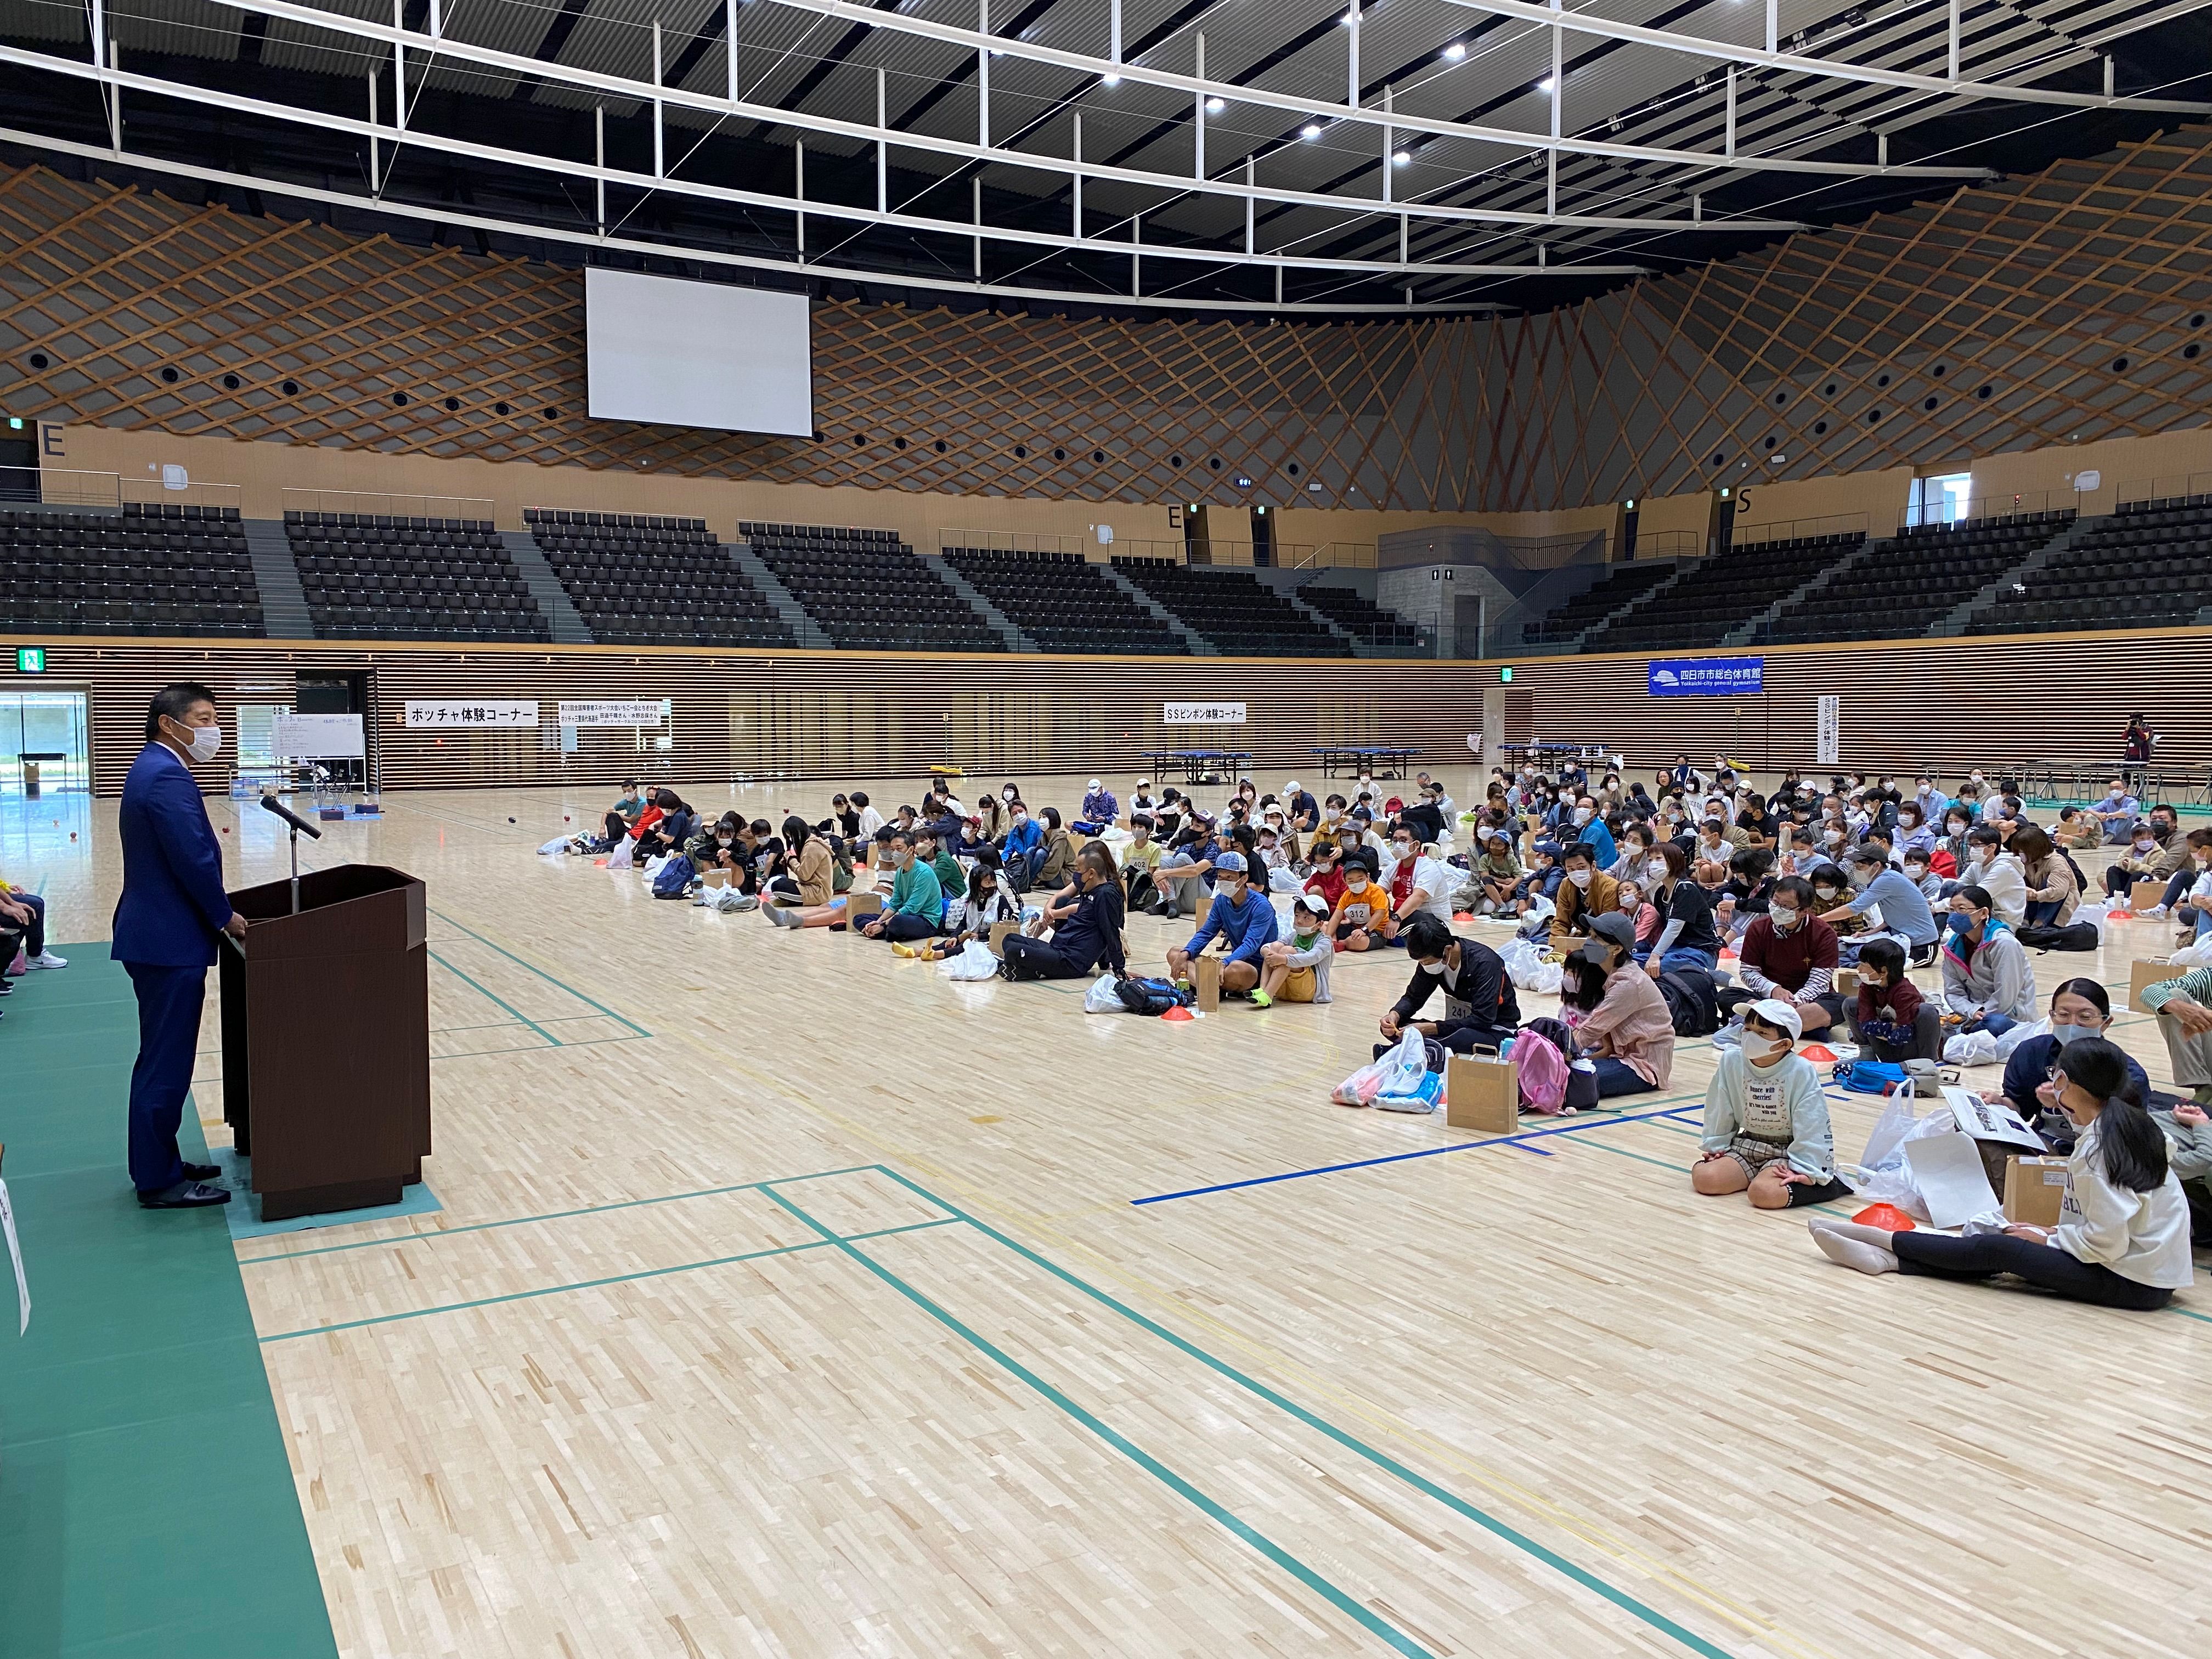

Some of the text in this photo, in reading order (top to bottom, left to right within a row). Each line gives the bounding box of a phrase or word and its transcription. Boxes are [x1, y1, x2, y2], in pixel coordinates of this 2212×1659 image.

[43, 425, 65, 456] E
[1738, 489, 1751, 513] S
[1169, 507, 1181, 528] E
[1680, 668, 1761, 680] 四日市市総合体育館
[412, 708, 532, 721] ボッチャ体験コーナー
[1167, 708, 1243, 720] SSピンポン体験コーナー
[1452, 1006, 1466, 1019] 241
